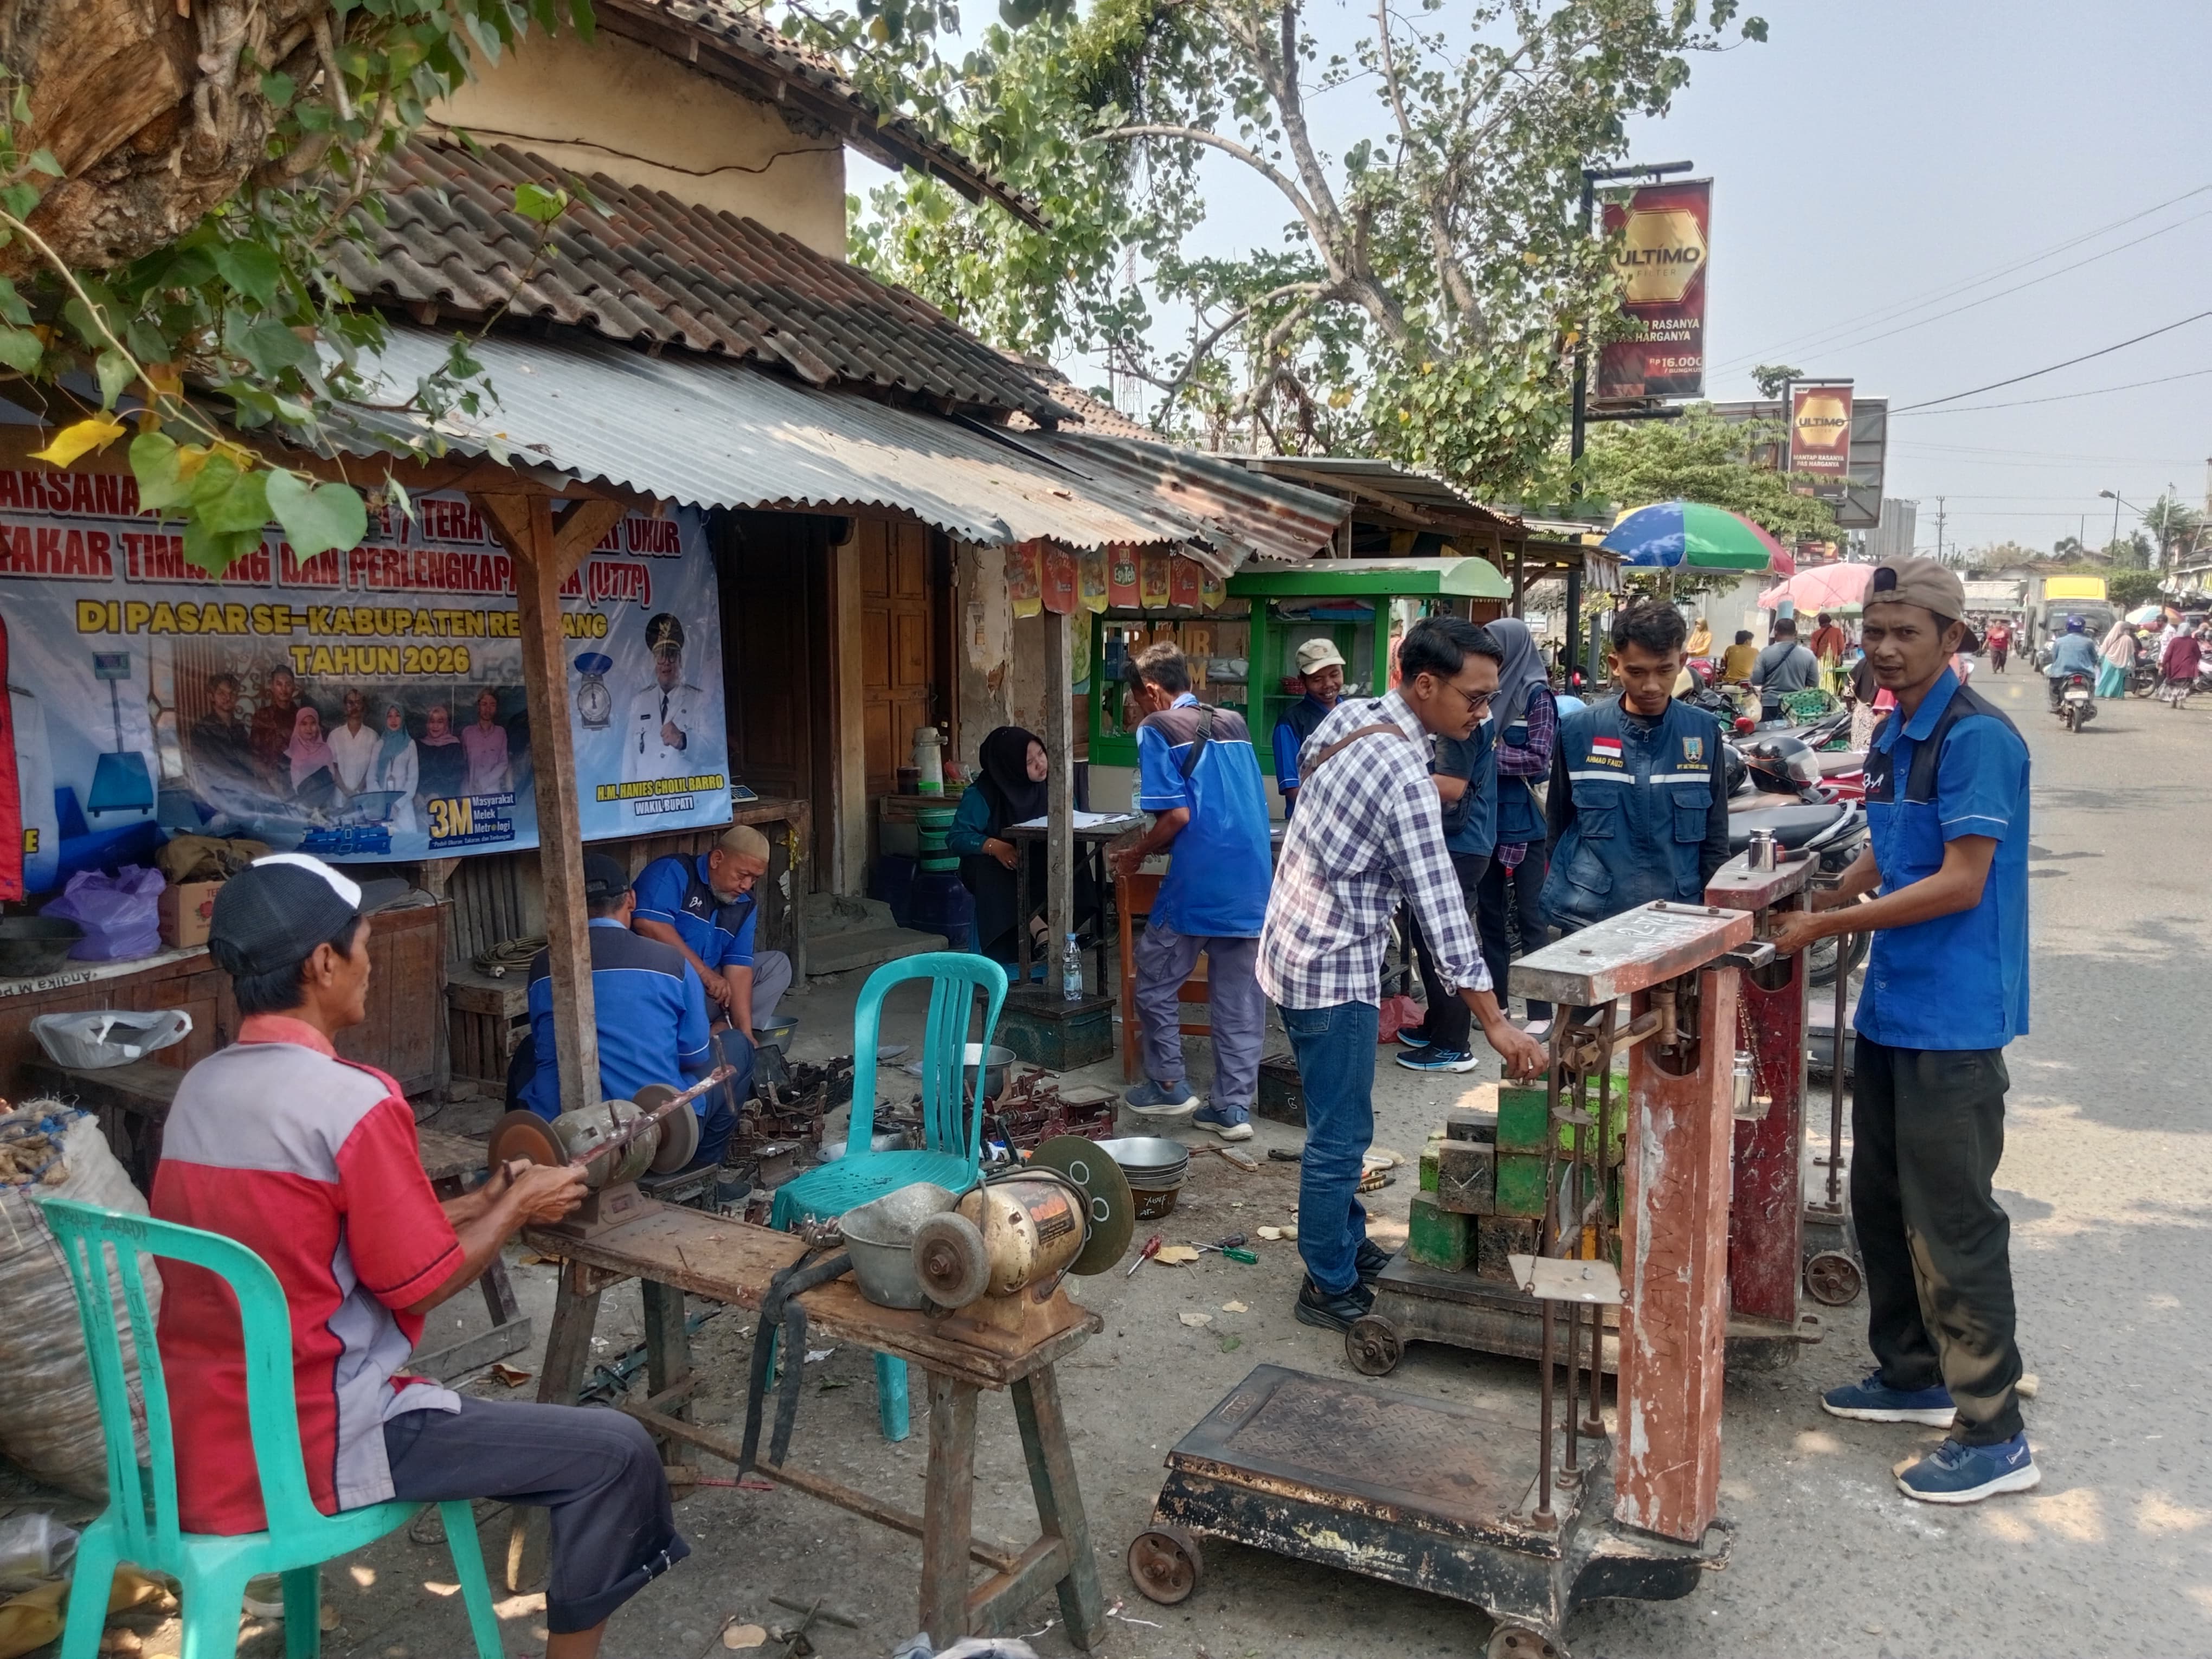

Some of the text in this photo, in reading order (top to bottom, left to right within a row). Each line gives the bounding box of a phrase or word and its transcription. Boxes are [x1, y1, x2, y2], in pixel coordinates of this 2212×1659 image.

[1637, 268, 1676, 277] FILTER
[1652, 318, 1699, 330] RASANYA
[1635, 331, 1690, 342] HARGANYA
[421, 498, 484, 541] TERA
[626, 518, 681, 555] UKUR
[280, 542, 340, 584] DAN
[588, 562, 651, 605] (UTTP)
[77, 600, 608, 639] DI PASAR SE-KABUPATEN REANG
[289, 645, 470, 674] TAHUN 2026
[1586, 755, 1624, 768] AHMAD FAUZI
[597, 774, 725, 801] H.M. HANIES CHOLIL BARRO
[473, 808, 496, 820] Melek
[634, 795, 695, 815] WAKIL BUPATI
[429, 794, 514, 838] 3M Masyarakat
[474, 820, 511, 834] Metrologi
